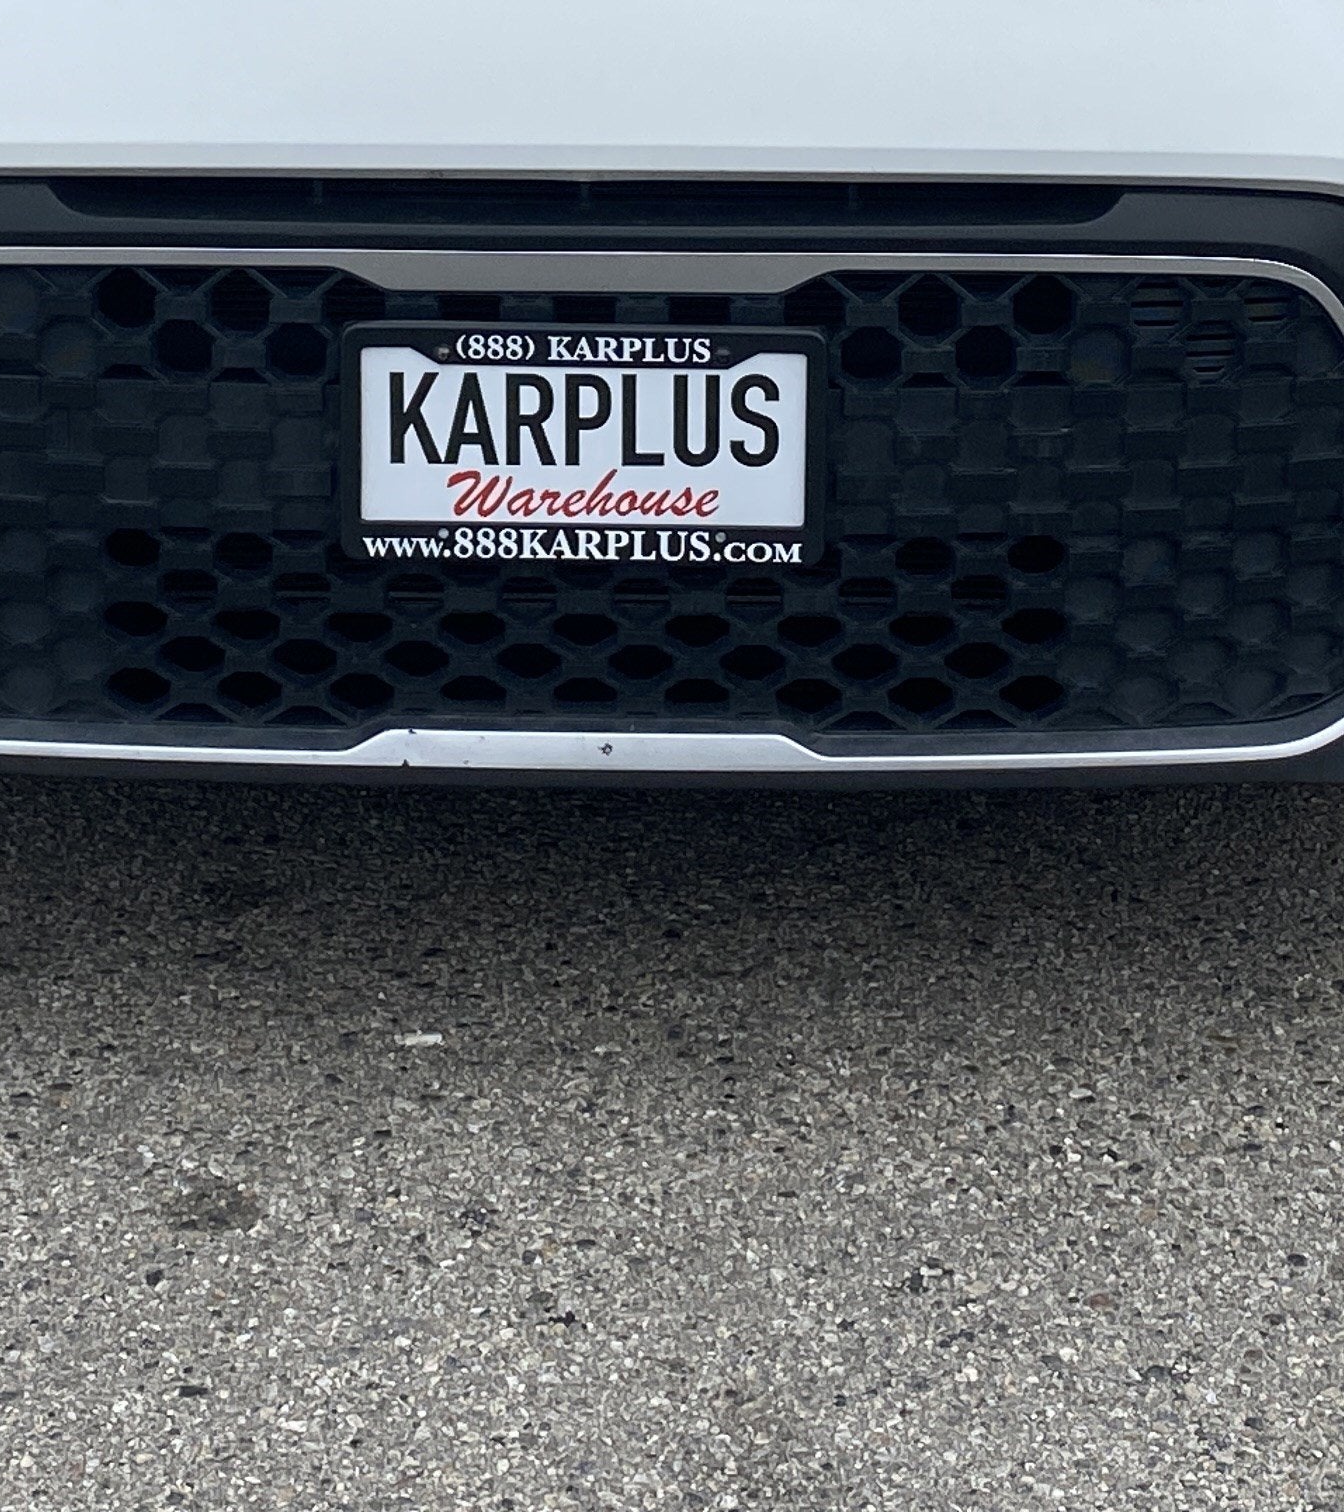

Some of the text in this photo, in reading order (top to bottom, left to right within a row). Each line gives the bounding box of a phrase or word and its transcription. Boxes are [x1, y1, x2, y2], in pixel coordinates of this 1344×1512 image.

[455, 334, 712, 364] (888) KARPLUS
[388, 371, 781, 469] KARPLUS
[446, 468, 721, 519] Warehouse
